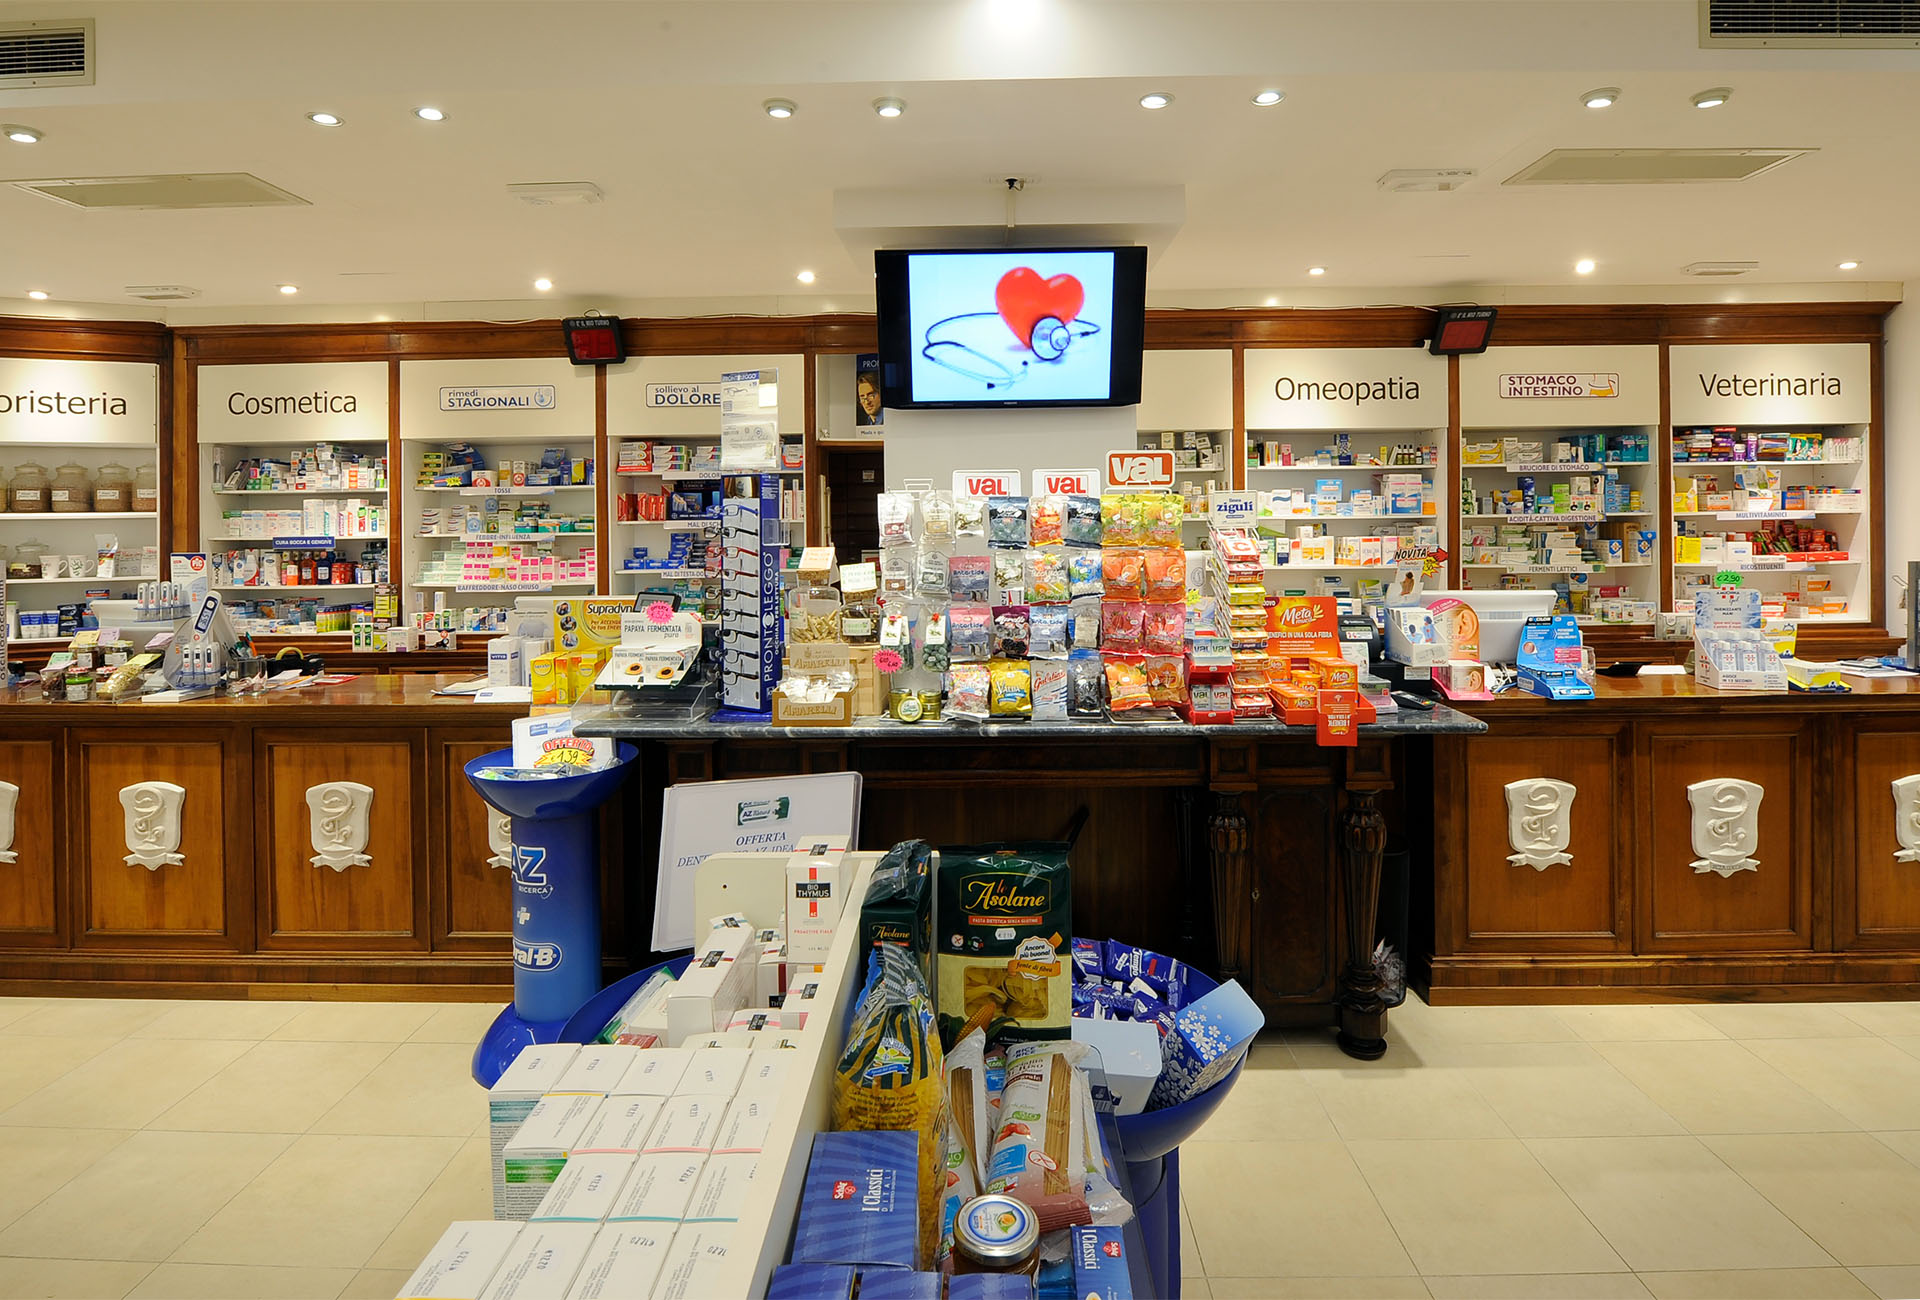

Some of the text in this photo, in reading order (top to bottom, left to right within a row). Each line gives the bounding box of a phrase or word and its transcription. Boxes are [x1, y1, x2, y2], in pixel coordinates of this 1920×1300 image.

[1508, 376, 1576, 386] STOMACO
[1699, 373, 1841, 396] Veterinaria
[448, 389, 478, 397] rimedi
[655, 385, 699, 393] sollievo al
[1275, 377, 1420, 405] Omeopatia
[1508, 386, 1583, 396] INTESTINO
[228, 391, 357, 415] Cosmetica
[448, 396, 529, 408] STAGIONALI
[655, 393, 720, 405] DOLORE
[1558, 514, 1596, 522] DIGESTIONE
[1282, 607, 1313, 625] Meta
[544, 738, 592, 752] OFFERTA
[742, 810, 752, 818] AZ
[736, 832, 786, 846] OFFERTA
[518, 886, 548, 894] RICERCA
[798, 890, 829, 898] THYMUS
[965, 880, 1045, 911] Asolane
[872, 925, 910, 939] Asolane
[1024, 944, 1045, 952] Ancora
[513, 948, 553, 966] ral-B
[1132, 948, 1142, 976] Tempo
[1016, 961, 1032, 970] fonte
[1032, 962, 1038, 970] di
[863, 1168, 884, 1204] Classici
[1082, 1234, 1100, 1270] Classici
